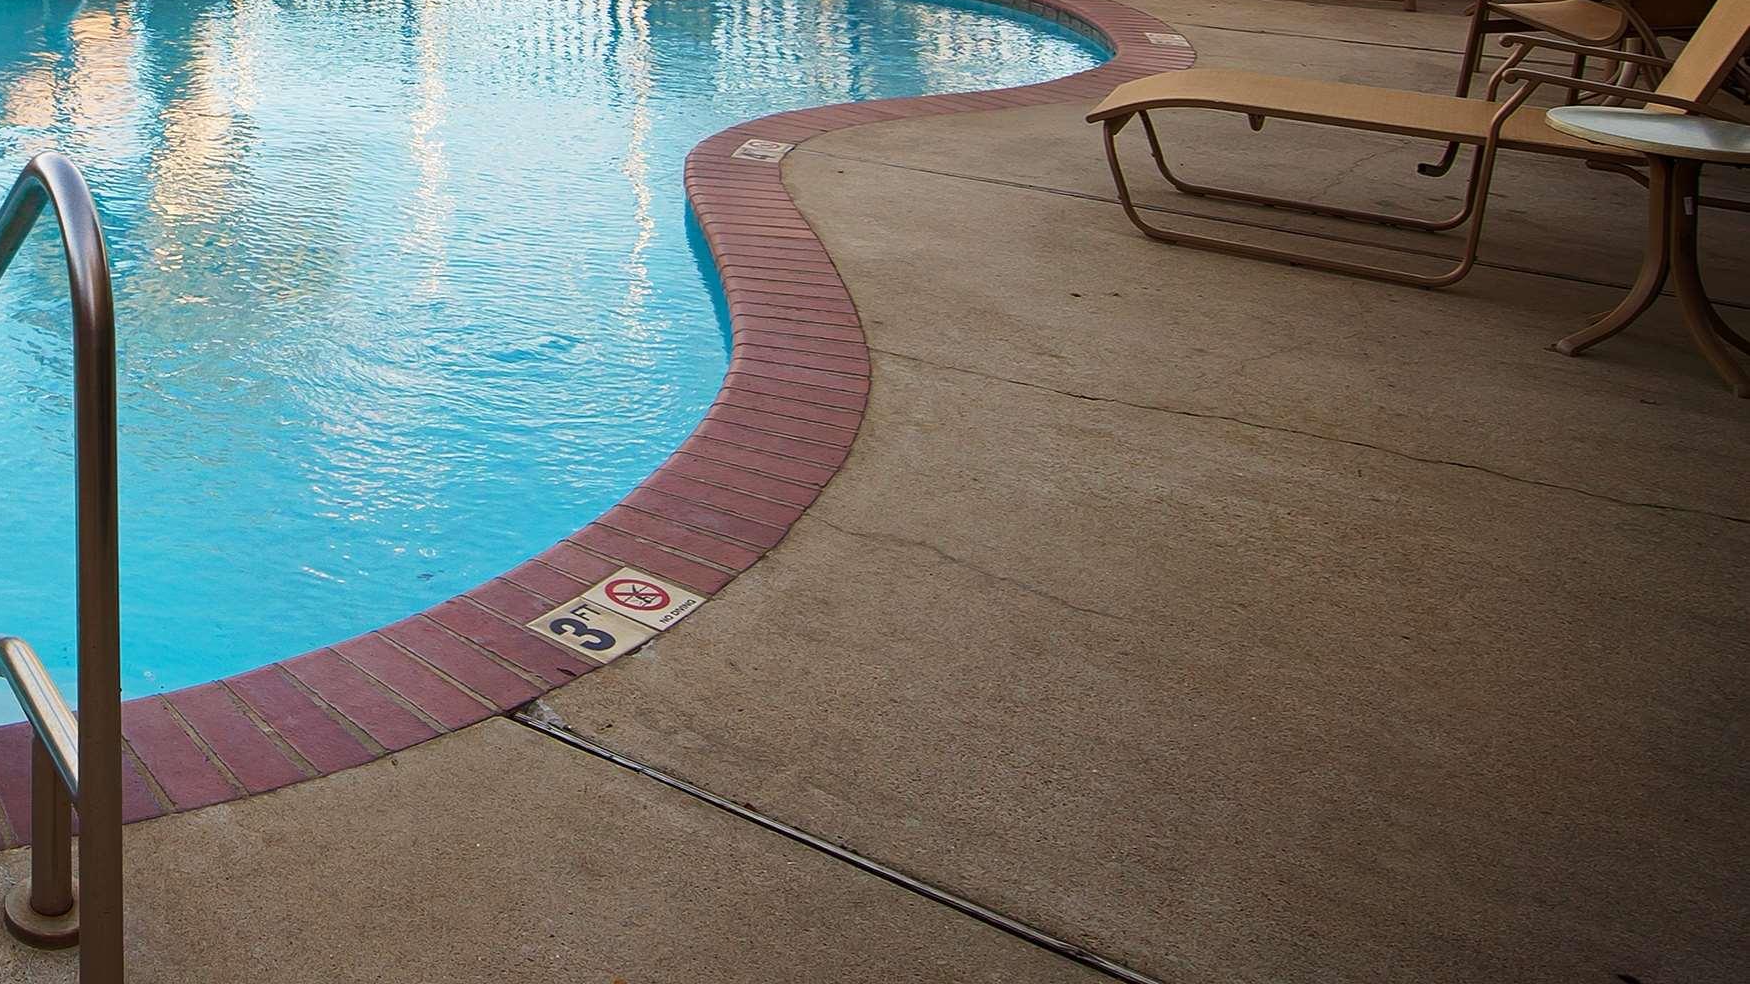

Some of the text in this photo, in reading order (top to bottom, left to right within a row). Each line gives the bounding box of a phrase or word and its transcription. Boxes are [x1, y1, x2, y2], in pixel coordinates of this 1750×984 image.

[549, 603, 617, 651] 3 FT
[659, 615, 673, 624] NO
